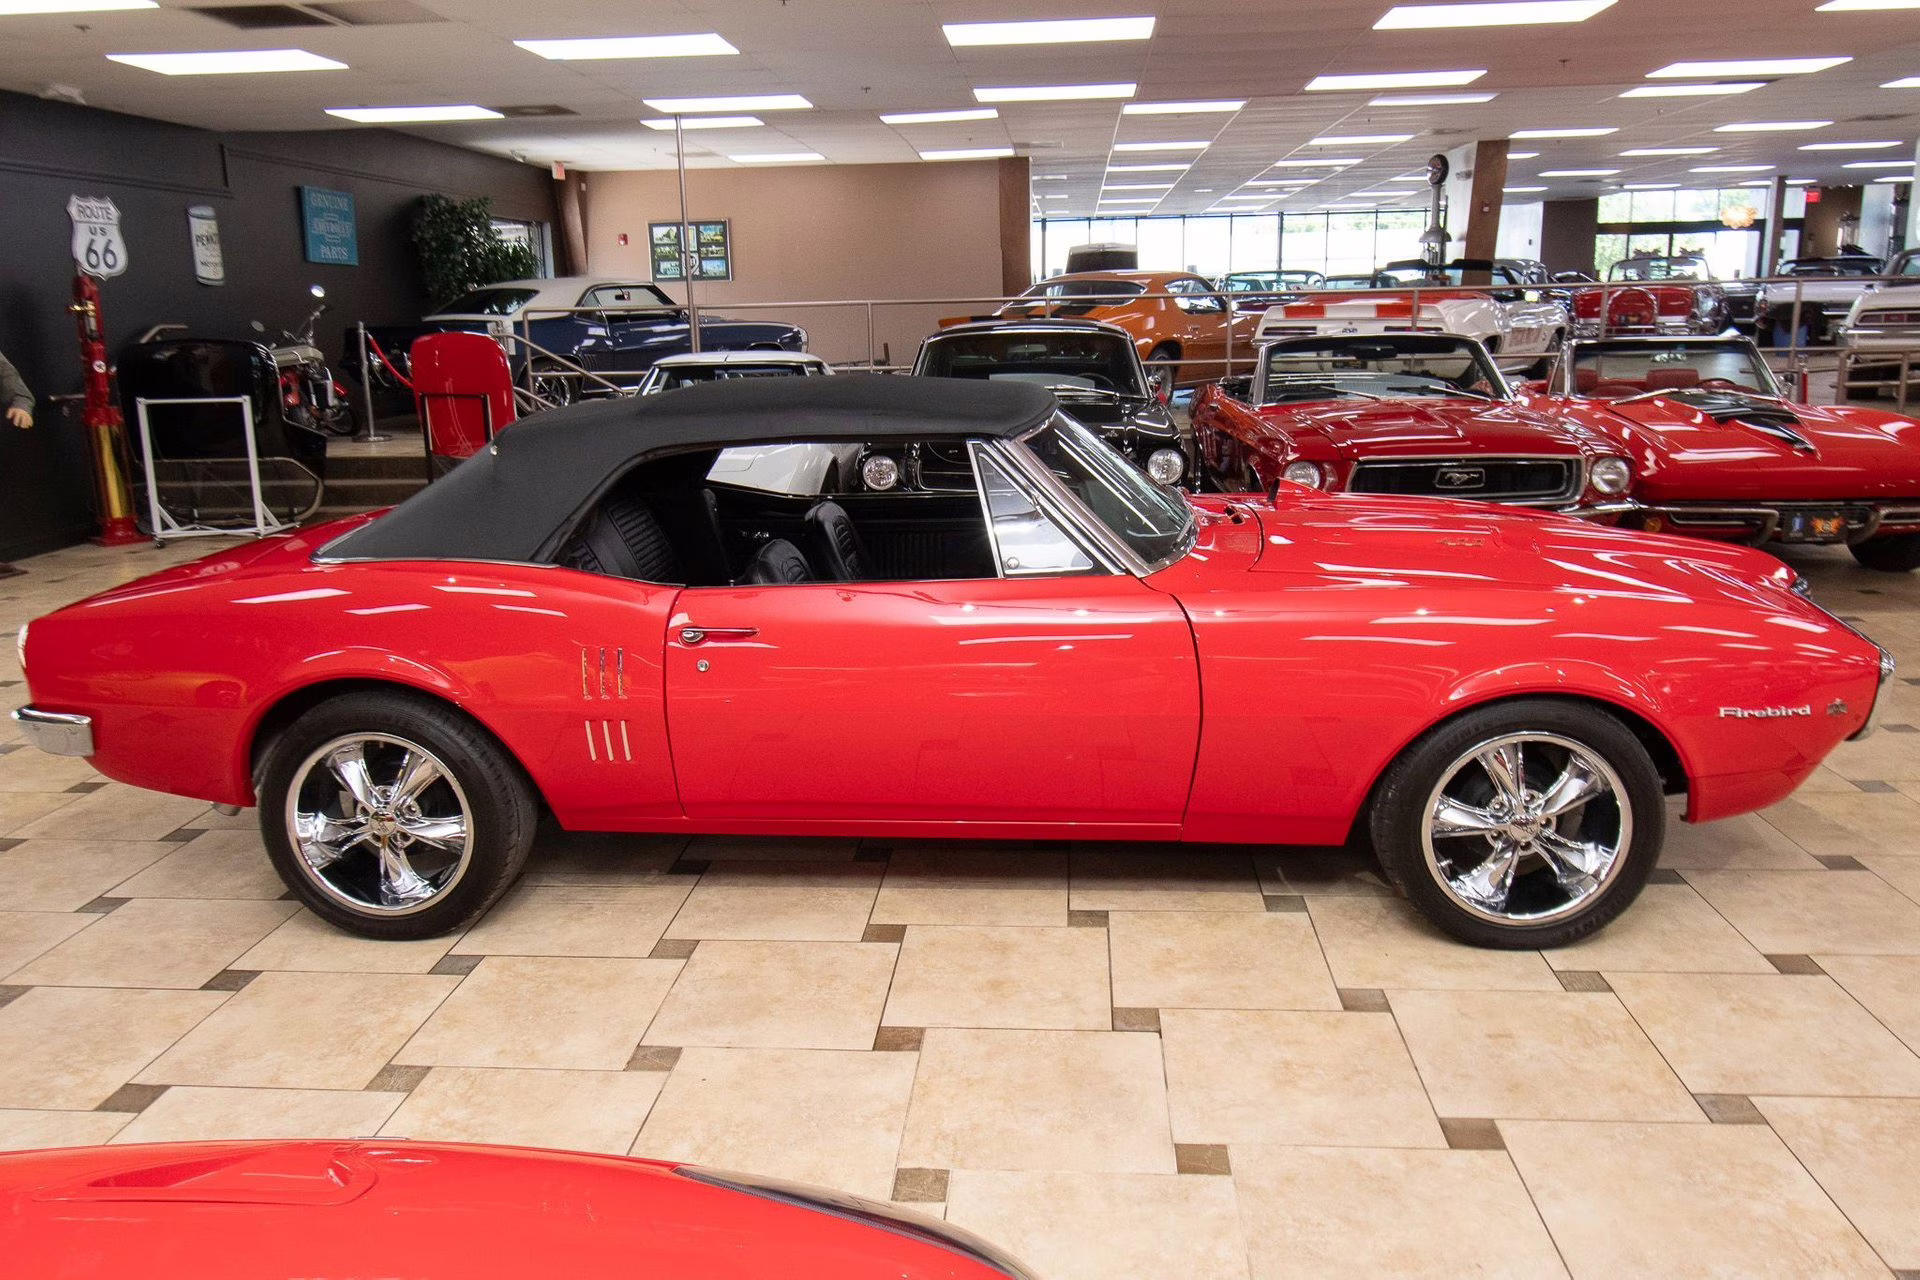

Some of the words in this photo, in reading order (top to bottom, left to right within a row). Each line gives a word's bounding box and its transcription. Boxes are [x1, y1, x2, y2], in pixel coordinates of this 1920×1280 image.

[312, 193, 348, 209] GENUINE
[77, 204, 113, 221] ROUTE
[88, 225, 108, 237] US
[86, 238, 118, 270] 66
[321, 245, 348, 259] PARTS
[1718, 704, 1812, 718] Firebird
